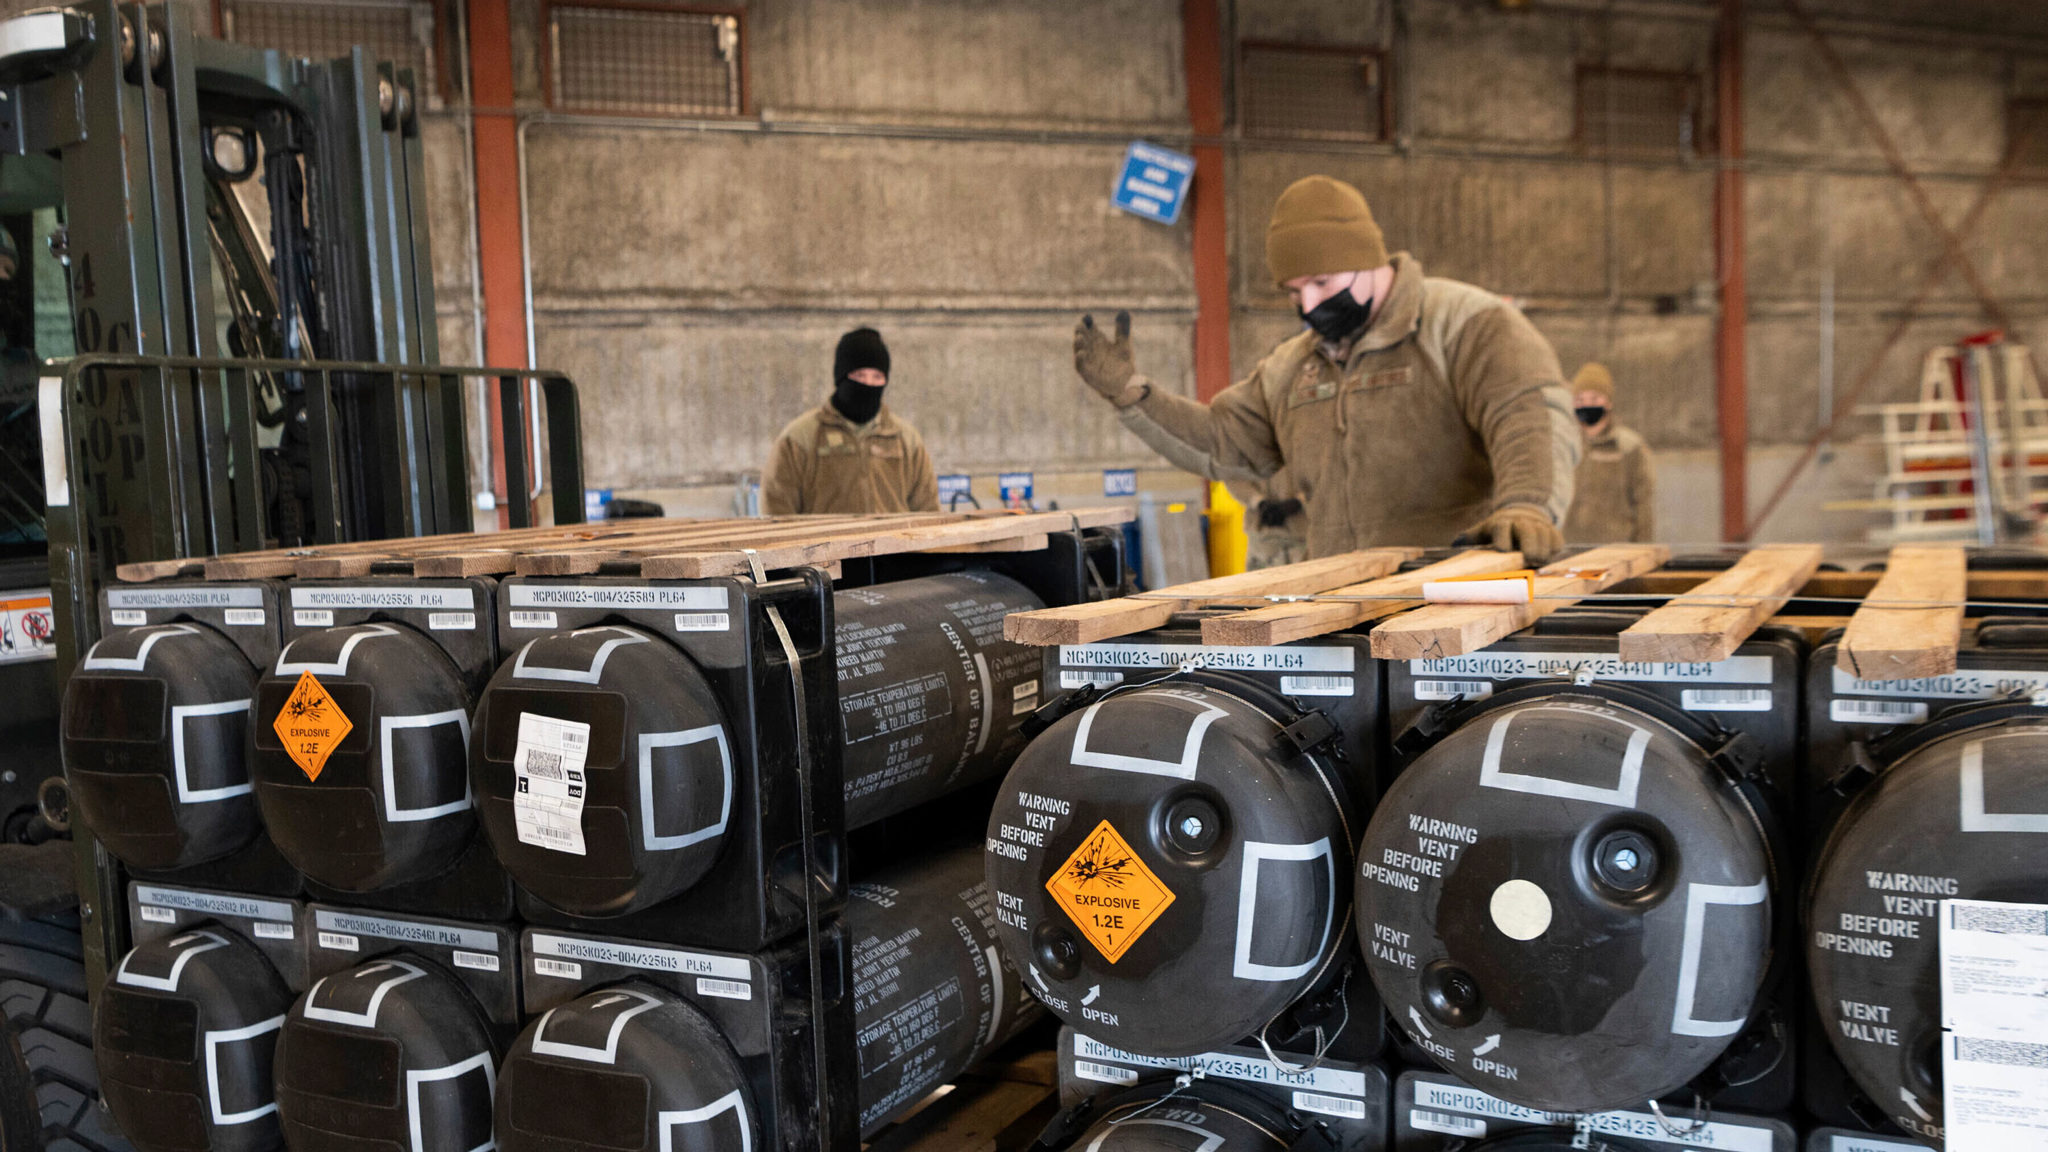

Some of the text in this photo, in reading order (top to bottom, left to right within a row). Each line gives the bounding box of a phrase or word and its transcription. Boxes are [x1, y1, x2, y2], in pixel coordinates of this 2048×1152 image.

[420, 594, 443, 606] PL64
[533, 590, 686, 603] MGP03K023-004/325589 PL64
[940, 622, 976, 682] CENTER
[970, 688, 980, 710] OF
[1263, 653, 1304, 668] PL64
[1663, 661, 1713, 676] PL64
[844, 678, 946, 713] STORAGE TEMPERATURE LIMITS
[884, 704, 894, 716] TO
[908, 698, 920, 710] DEG
[922, 694, 926, 706] F
[888, 718, 898, 728] TO
[908, 711, 920, 723] DEG
[922, 708, 926, 718] C
[290, 728, 330, 738] EXPLOSIVE
[910, 734, 924, 747] LBS
[300, 742, 318, 754] 1.2E
[1019, 791, 1070, 816] WARNING
[1025, 810, 1056, 832] VENT
[1409, 813, 1478, 845] WARNING
[1000, 824, 1044, 848] BEFORE
[986, 837, 1028, 862] OPENING
[1418, 836, 1459, 862] VENT
[1384, 848, 1443, 879] BEFORE
[1362, 861, 1420, 892] OPENING
[1866, 870, 1959, 896] WARNING
[996, 890, 1024, 912] VENT
[1075, 894, 1140, 910] EXPLOSIVE
[1882, 895, 1938, 918] VENT
[996, 906, 1028, 930] VALVE
[1092, 914, 1124, 930] 1.2E
[1840, 912, 1920, 939] BEFORE
[439, 933, 462, 944] PL64
[1106, 934, 1112, 946] 1
[1374, 923, 1411, 948] VENT
[1815, 931, 1894, 958] OPENING
[557, 942, 713, 972] MGP03K023-004/325613 PL64
[860, 946, 912, 978] JOINT VENTURE
[952, 916, 988, 978] CENTER
[980, 984, 992, 1004] OF
[1372, 940, 1416, 970] VALVE
[874, 966, 902, 986] MARTIN
[868, 993, 880, 1006] AL
[1032, 986, 1070, 1013] CLOSE
[860, 982, 958, 1047] STORAGE TEMPERATURE LIMITS
[899, 1026, 908, 1038] TO
[920, 1011, 934, 1026] DEG
[934, 1006, 939, 1018] F
[1082, 1006, 1120, 1027] OPEN
[1841, 1000, 1891, 1024] VENT
[903, 1037, 912, 1049] TO
[1839, 1020, 1900, 1046] VALVE
[1407, 1030, 1456, 1062] CLOSE
[1472, 1056, 1518, 1082] OPEN
[1144, 1108, 1208, 1124] FWD
